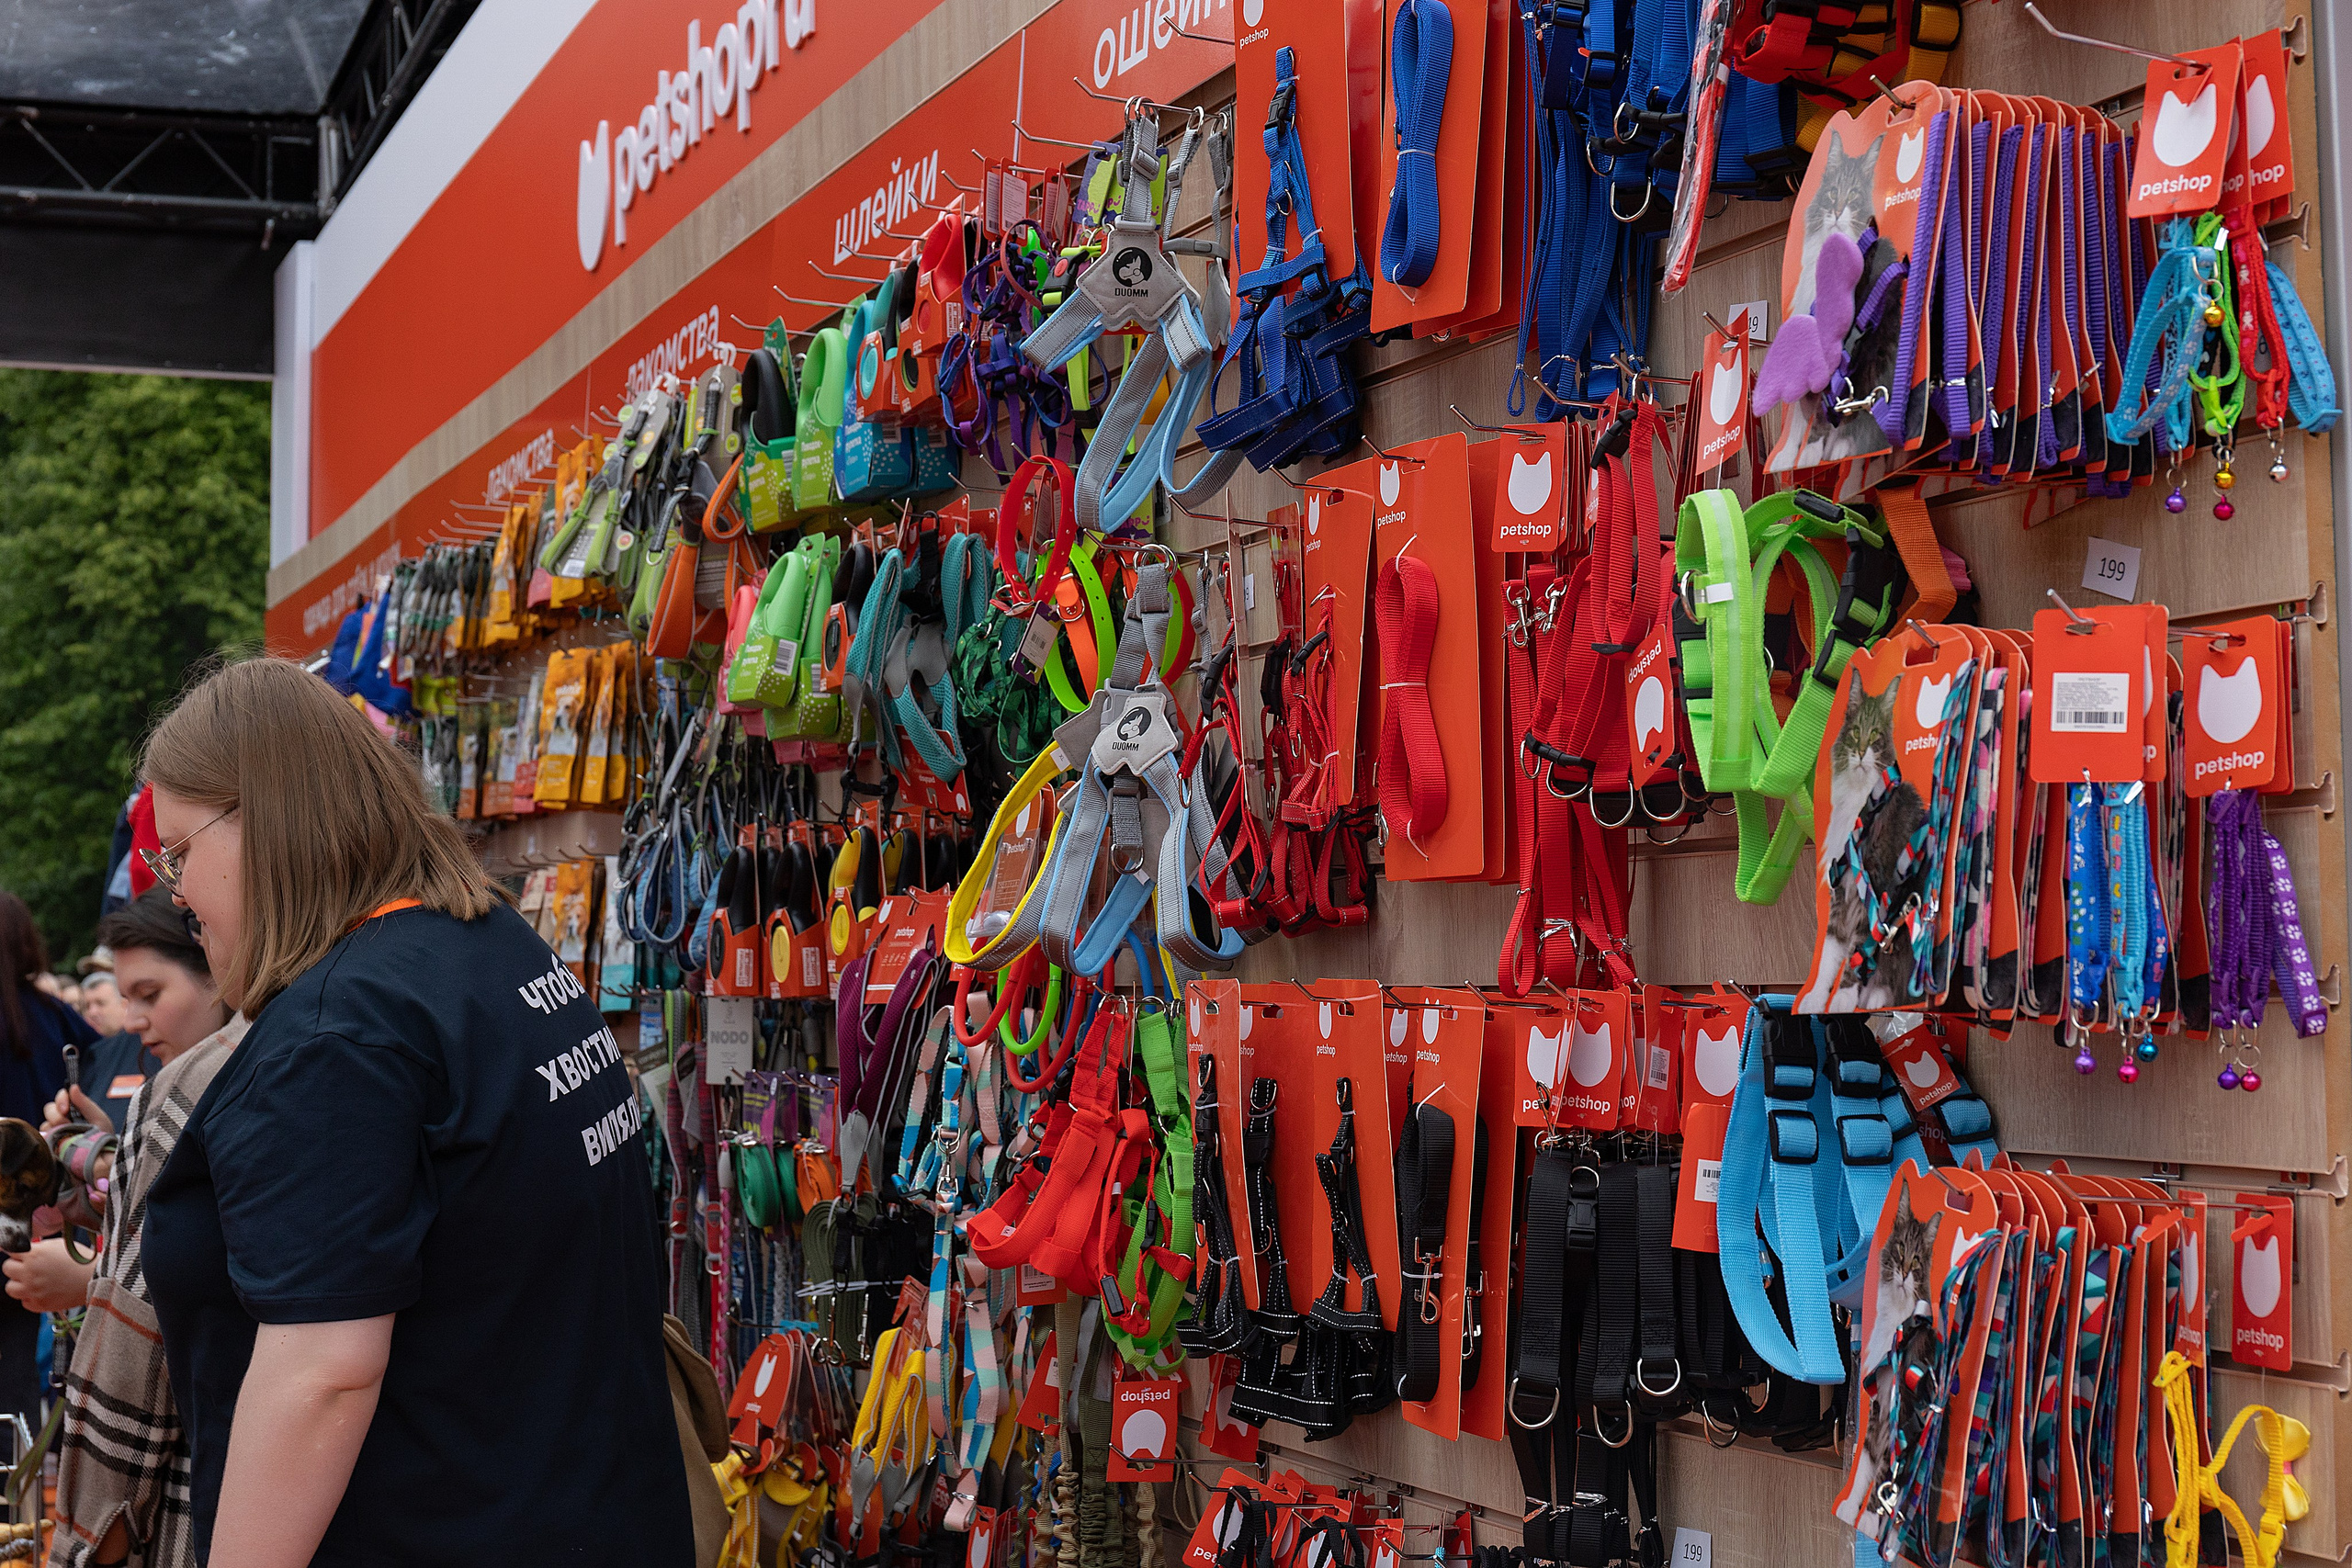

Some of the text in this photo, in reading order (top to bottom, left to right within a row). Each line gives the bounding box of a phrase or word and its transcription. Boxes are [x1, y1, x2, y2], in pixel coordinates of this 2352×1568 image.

[1239, 28, 1269, 50] petshop
[1883, 186, 1922, 211] petshop
[2137, 174, 2212, 201] petshop
[832, 148, 938, 266] шлейки
[1114, 288, 1148, 298] DUOMM
[1702, 425, 1741, 459] petshop
[1377, 510, 1407, 530] petshop
[1499, 521, 1552, 539] petshop
[1306, 538, 1321, 556] petshop
[2098, 557, 2126, 581] 199
[1628, 639, 1662, 683] petshop
[1112, 741, 1140, 751] DUOMM
[1905, 733, 1939, 755] petsh
[2194, 750, 2265, 780] petshop
[1240, 1044, 1255, 1058] shop
[1317, 1043, 1336, 1057] petshop
[1416, 1049, 1440, 1066] petshop
[535, 1025, 621, 1102] хвости
[1919, 1082, 1952, 1105] petshop
[2236, 1326, 2284, 1352] petshop
[1120, 1389, 1170, 1404] petshop
[1683, 1543, 1702, 1562] 199
